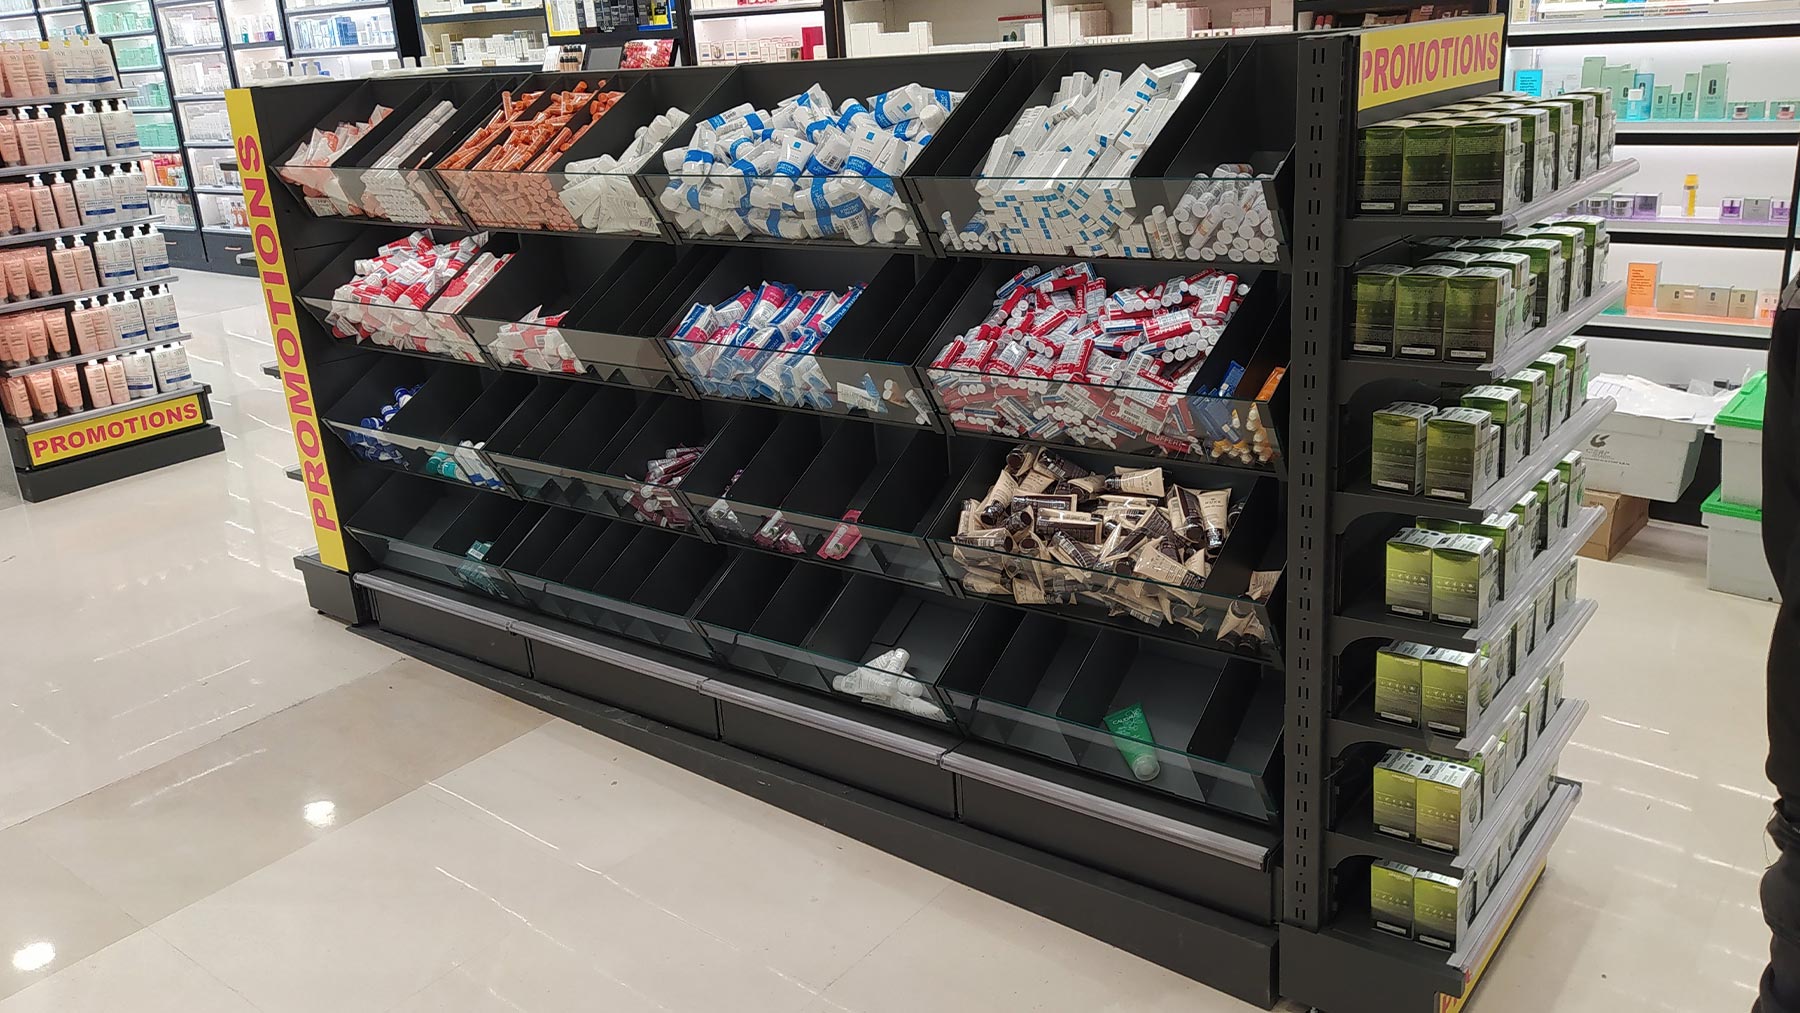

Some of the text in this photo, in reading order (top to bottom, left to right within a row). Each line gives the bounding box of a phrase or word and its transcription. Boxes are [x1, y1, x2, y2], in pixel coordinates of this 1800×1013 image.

[1360, 31, 1499, 97] PROMOTIONS
[237, 135, 337, 531] PROMOTIONS
[1153, 325, 1183, 336] OFFERT
[33, 403, 198, 458] PROMOTIONS
